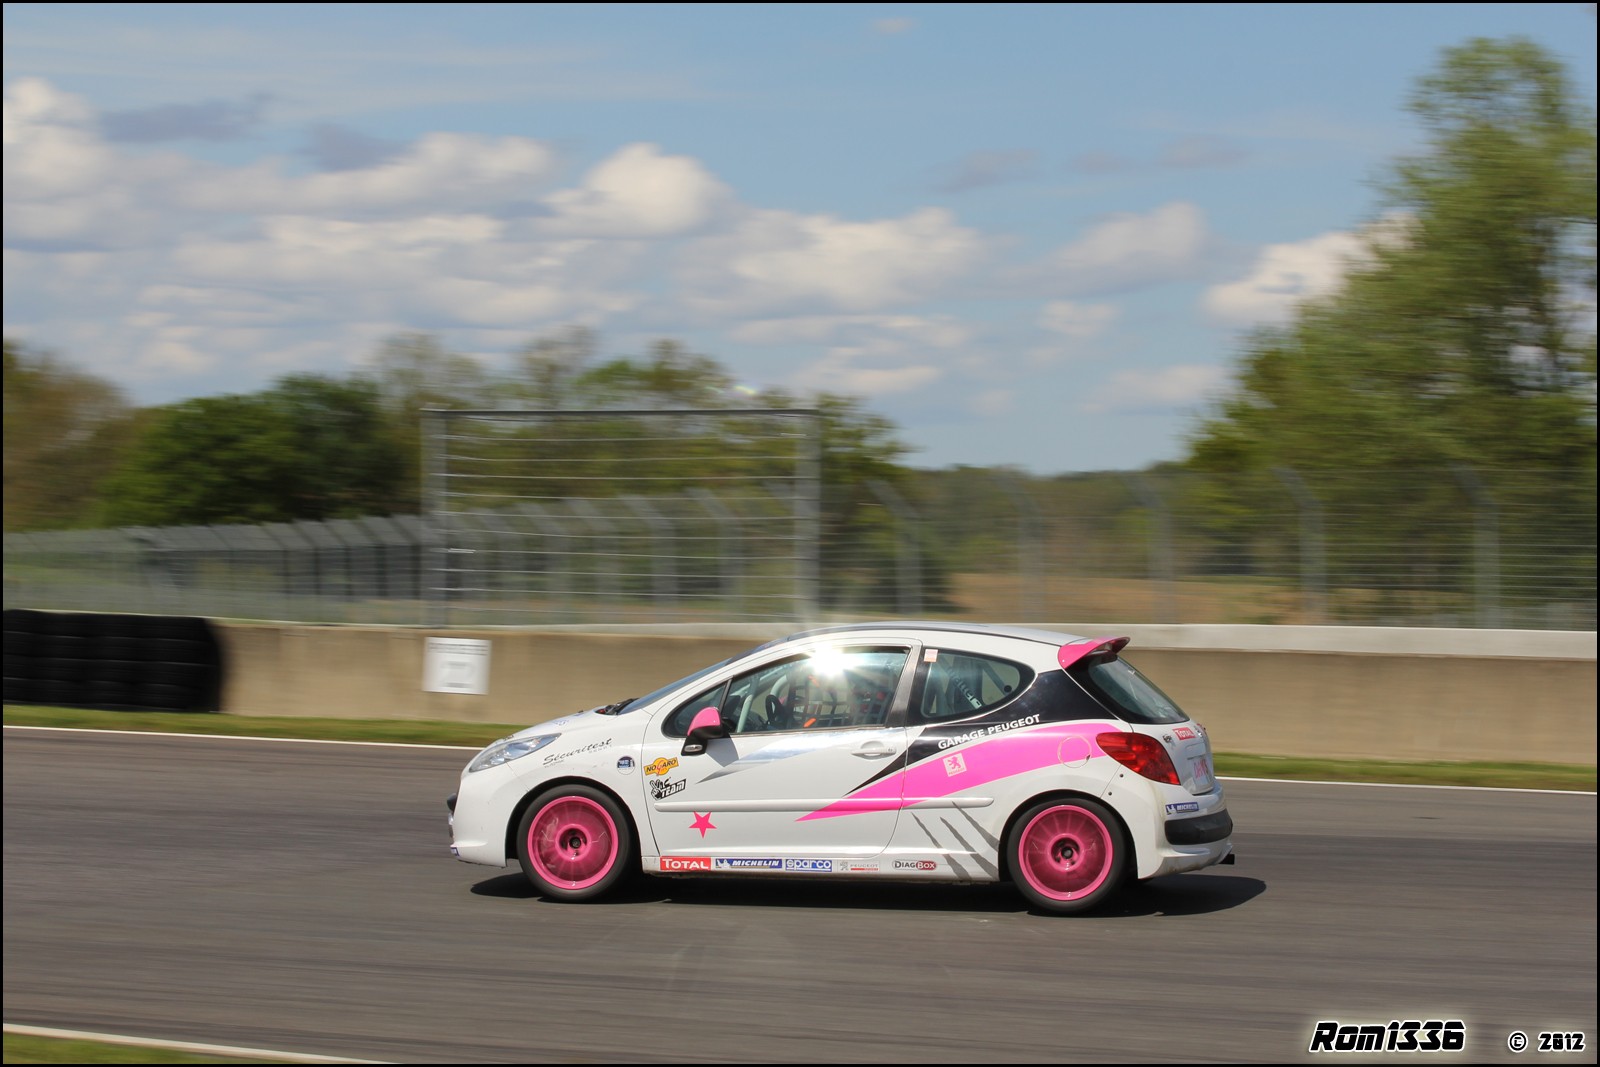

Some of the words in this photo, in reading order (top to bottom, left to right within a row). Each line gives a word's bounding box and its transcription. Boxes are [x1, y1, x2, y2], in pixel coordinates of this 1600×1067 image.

[938, 729, 986, 749] GARAGE
[987, 714, 1040, 734] PEUGEOT
[662, 858, 709, 870] TOTAL
[731, 859, 779, 867] MICHELIN
[786, 859, 832, 870] sparco
